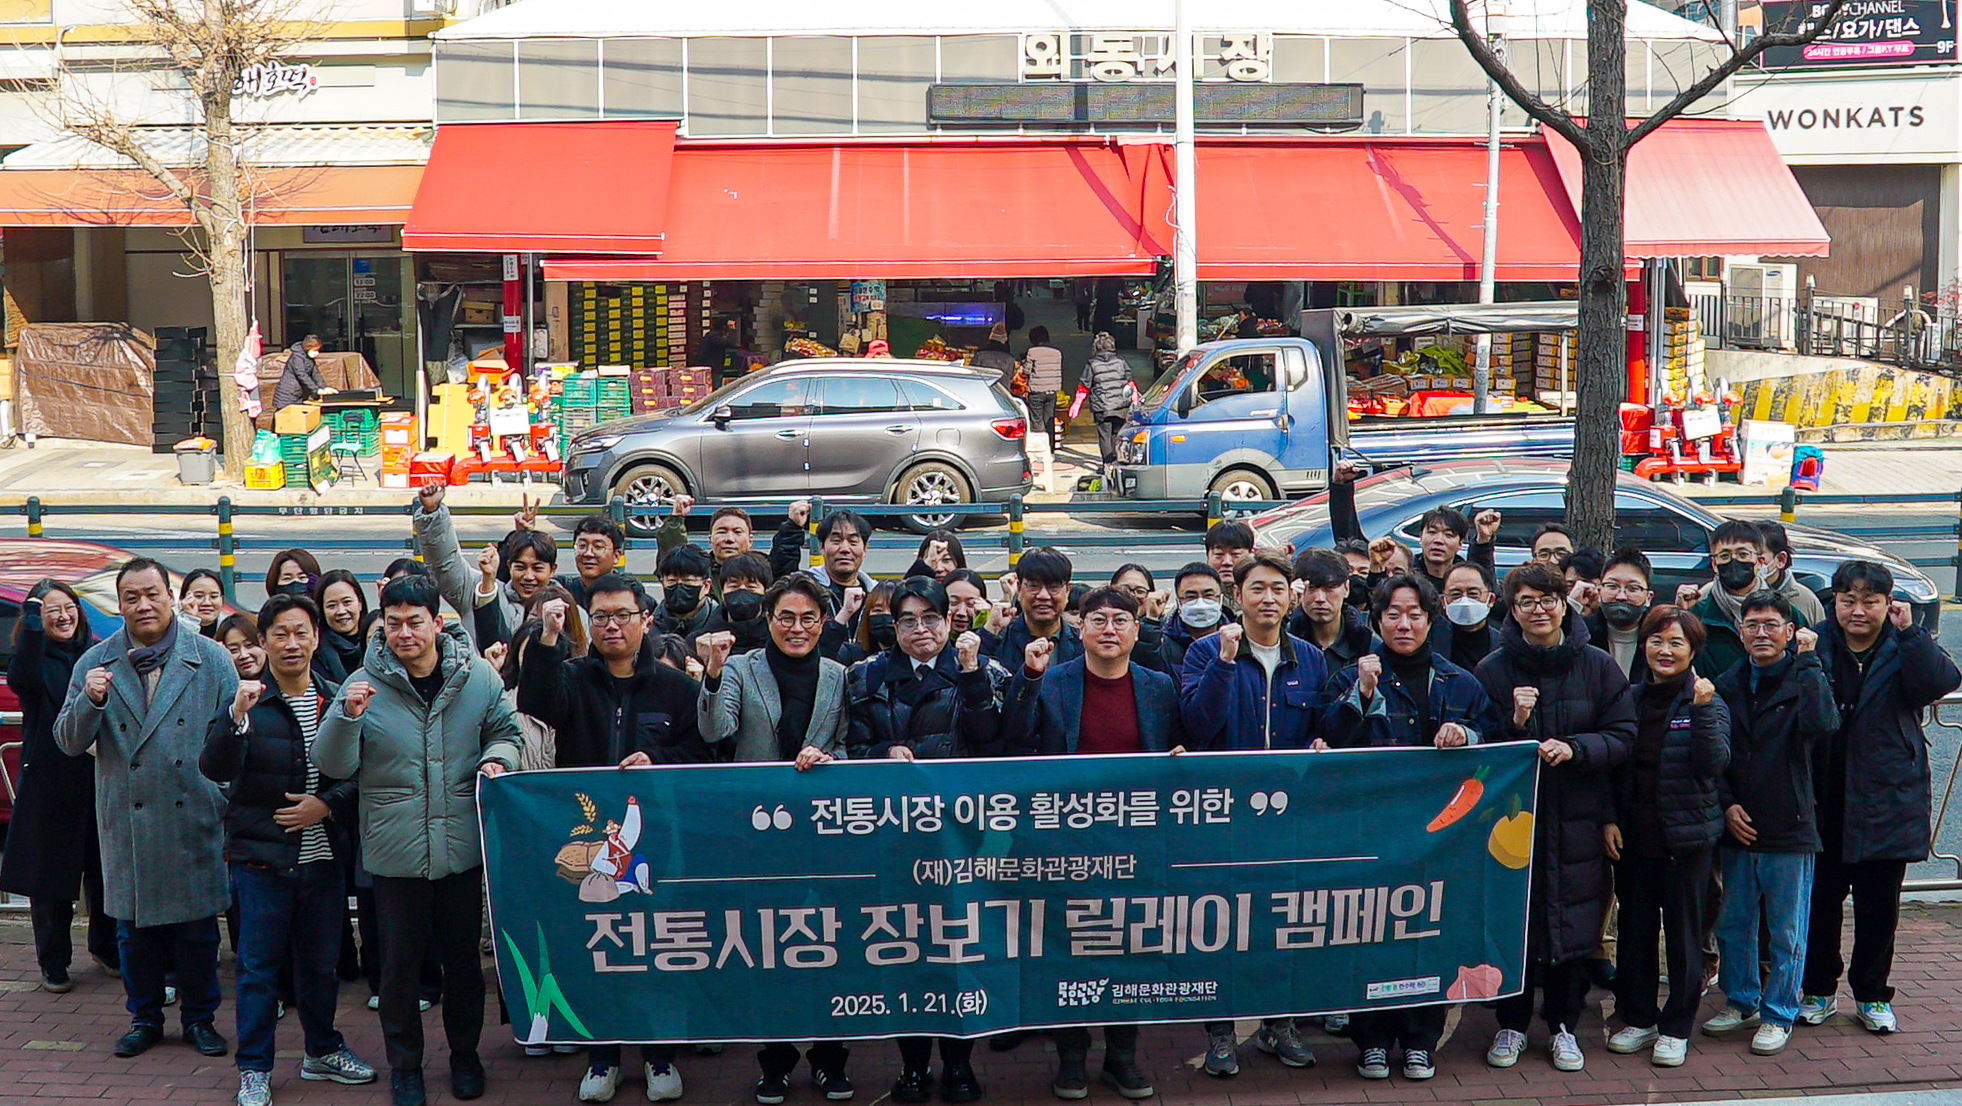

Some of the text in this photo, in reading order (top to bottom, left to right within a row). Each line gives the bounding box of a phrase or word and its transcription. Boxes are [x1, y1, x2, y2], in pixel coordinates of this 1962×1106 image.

[1937, 40, 1954, 54] 9F
[1768, 105, 1924, 130] WONKATS
[811, 789, 1234, 834] 전통시장 이용 활성화를 위한
[913, 855, 1137, 885] (재)김해문화관광재단
[584, 881, 1444, 974] 전통시장 장보기 릴레이 캠페인
[831, 989, 987, 1018] 2025. 1. 21.(화)
[1111, 981, 1218, 997] 김해문화관광재단
